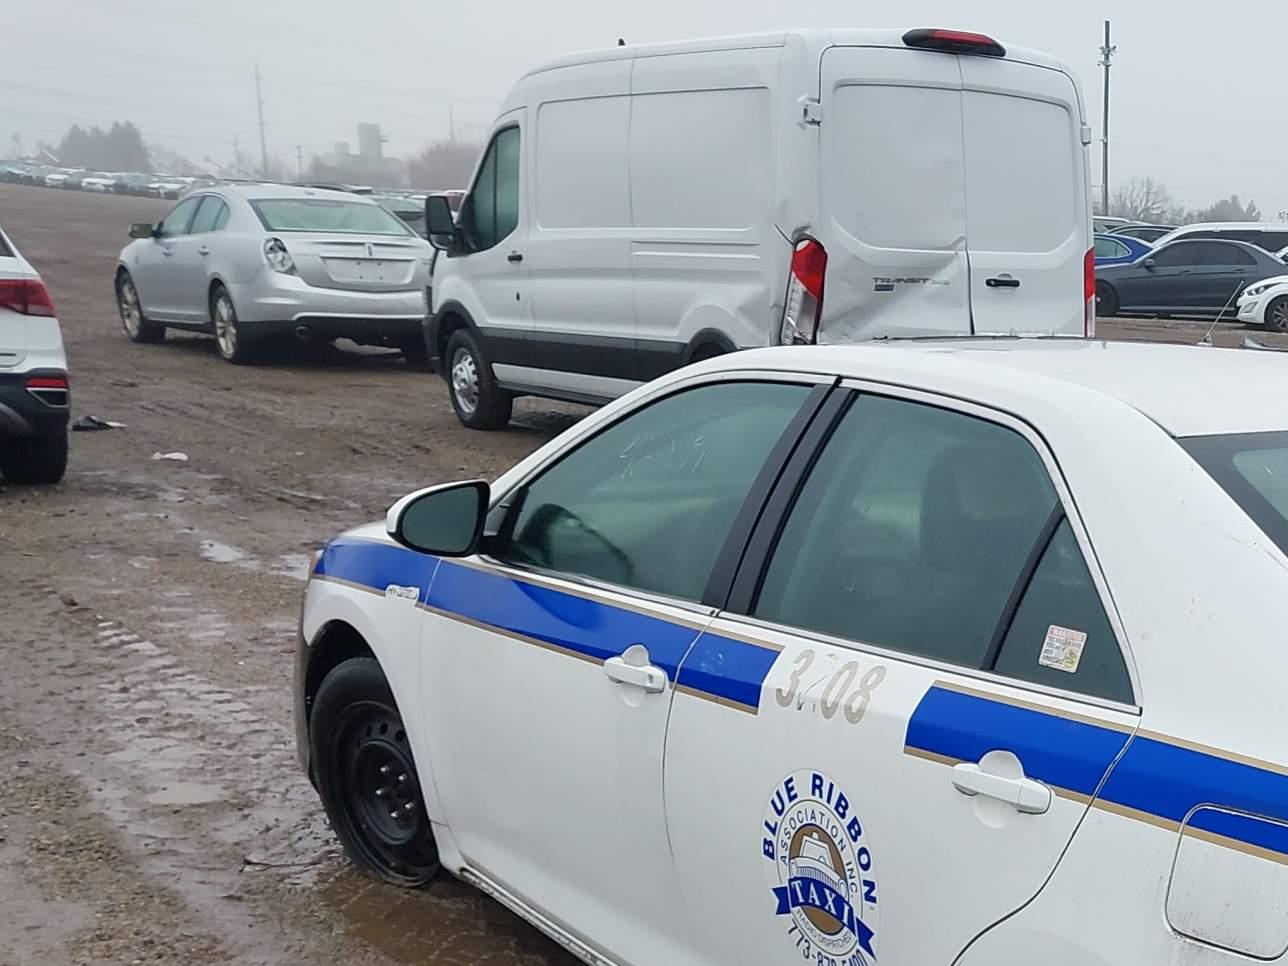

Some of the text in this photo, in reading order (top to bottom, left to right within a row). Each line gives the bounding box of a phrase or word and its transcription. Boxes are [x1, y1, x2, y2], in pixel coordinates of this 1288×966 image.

[775, 648, 888, 725] 308
[763, 772, 877, 904] BLUE RIBBON
[779, 808, 859, 899] ASSOCIATION INC.
[791, 879, 851, 926] TAXI
